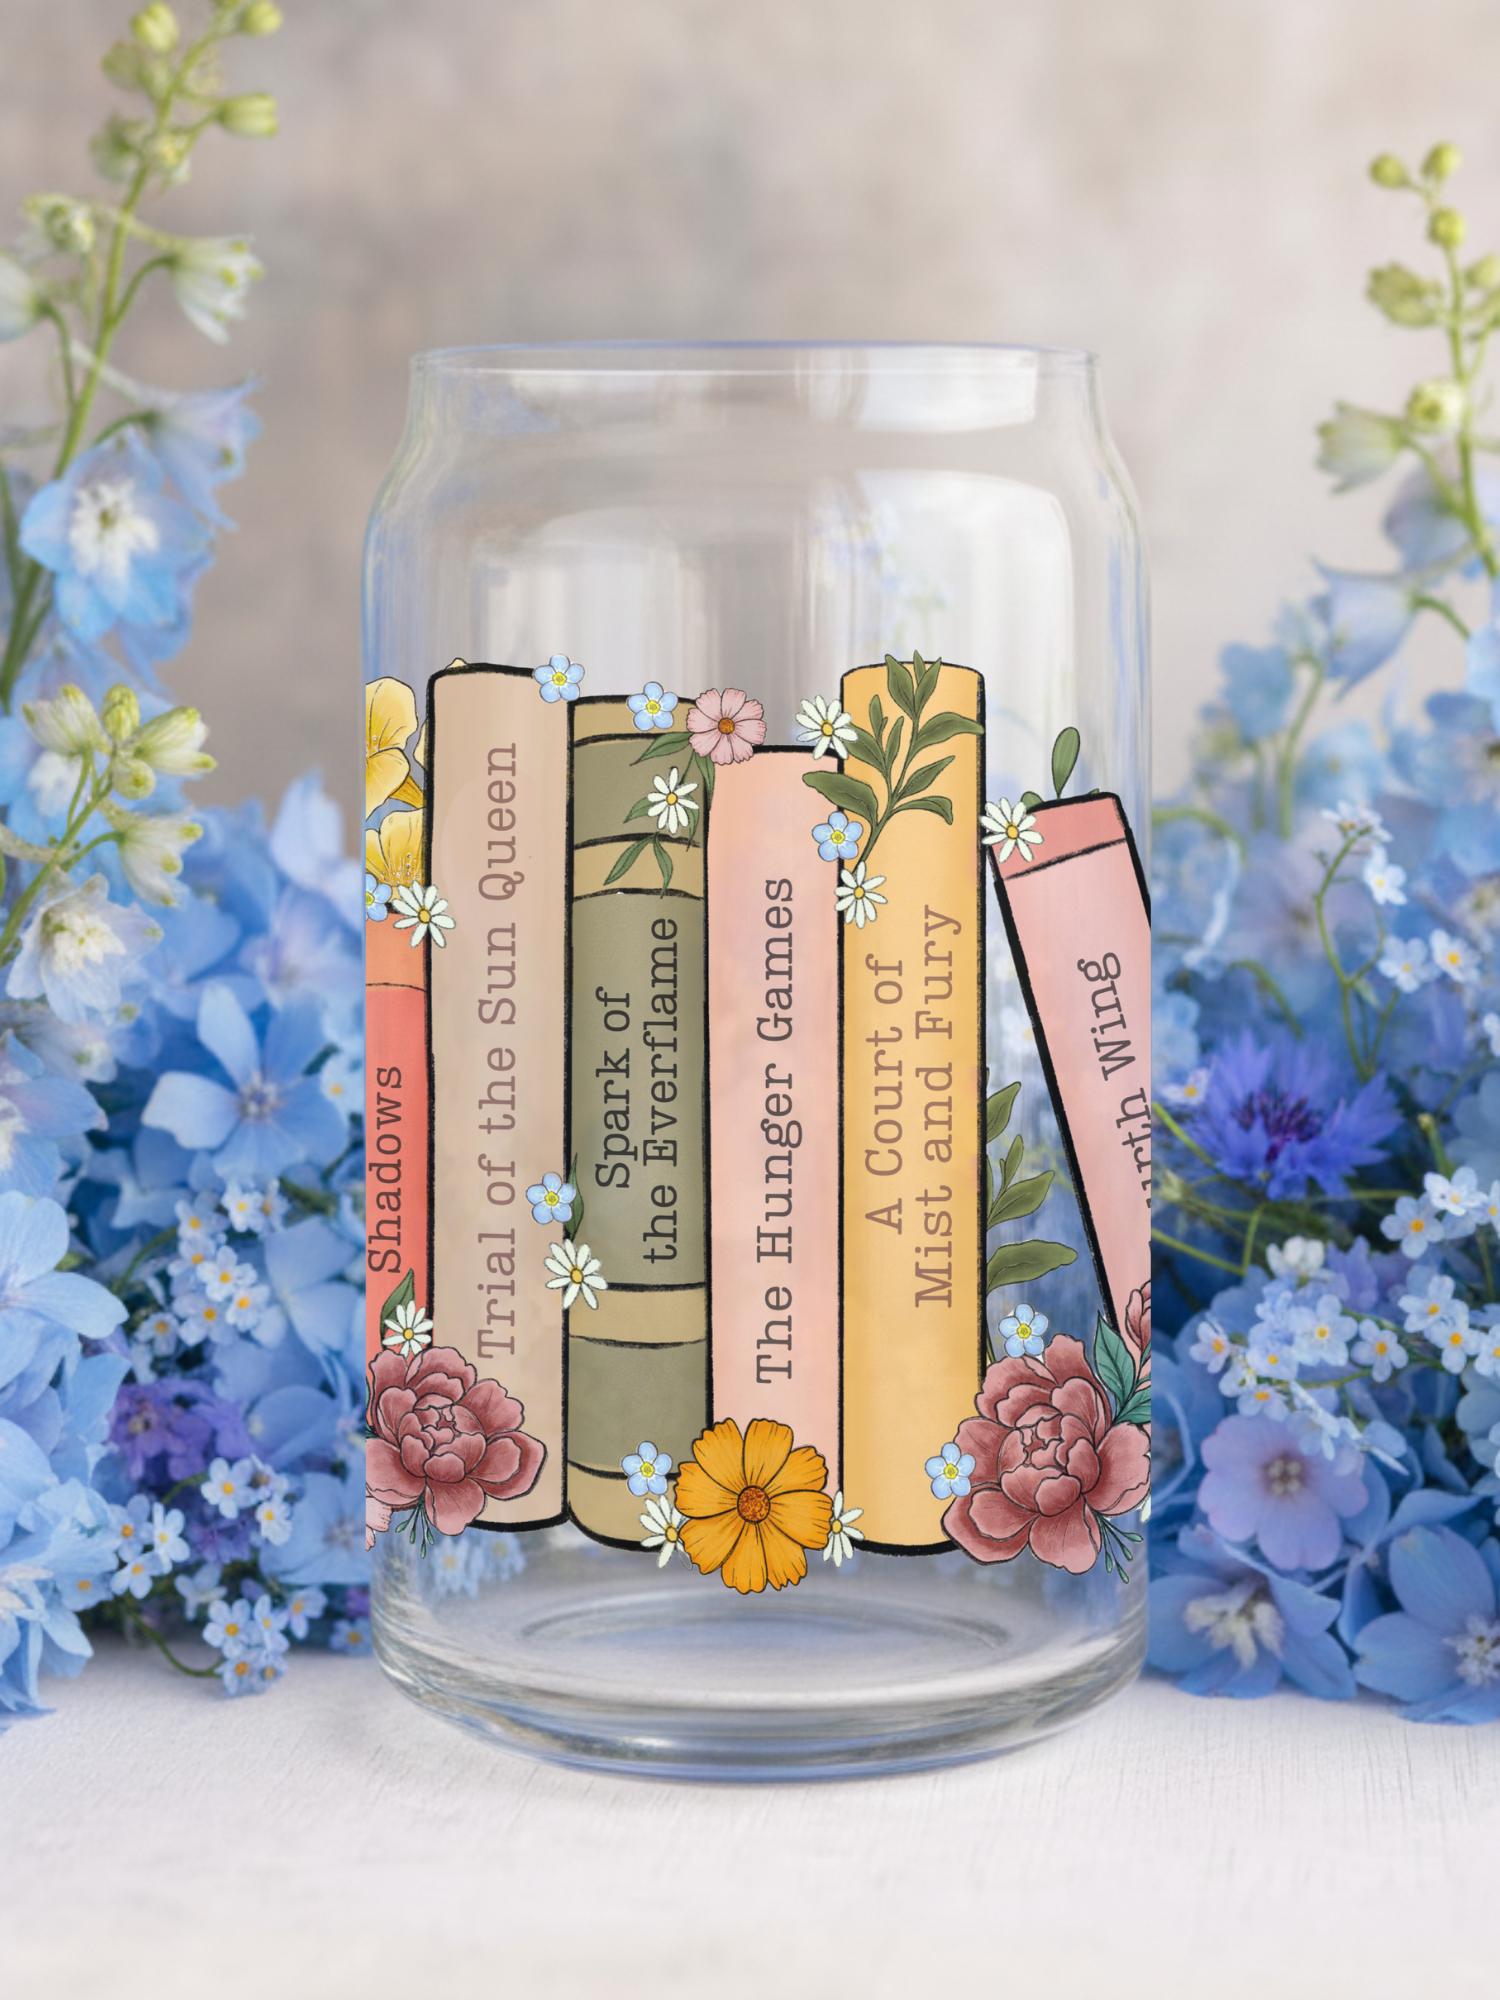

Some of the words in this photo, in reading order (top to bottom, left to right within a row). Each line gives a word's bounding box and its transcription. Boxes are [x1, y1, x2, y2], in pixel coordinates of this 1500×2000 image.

[478, 743, 524, 900] Queen
[478, 923, 516, 1024] Sun
[595, 986, 630, 1032] of
[756, 879, 793, 1041] Games
[865, 954, 902, 1004] of
[915, 905, 961, 1039] Fury
[1077, 952, 1136, 1081] Wing
[478, 1048, 515, 1134] the
[643, 918, 677, 1167] Everflame
[865, 1027, 902, 1176] Court
[367, 1066, 402, 1273] Shadows
[595, 1048, 638, 1188] Spark
[757, 1063, 802, 1264] Hunger
[915, 1062, 952, 1163] and
[478, 1154, 515, 1205] of
[643, 1185, 677, 1264] the
[865, 1198, 902, 1235] A
[478, 1228, 515, 1358] Trial
[915, 1185, 952, 1308] Mist
[756, 1286, 792, 1384] The
